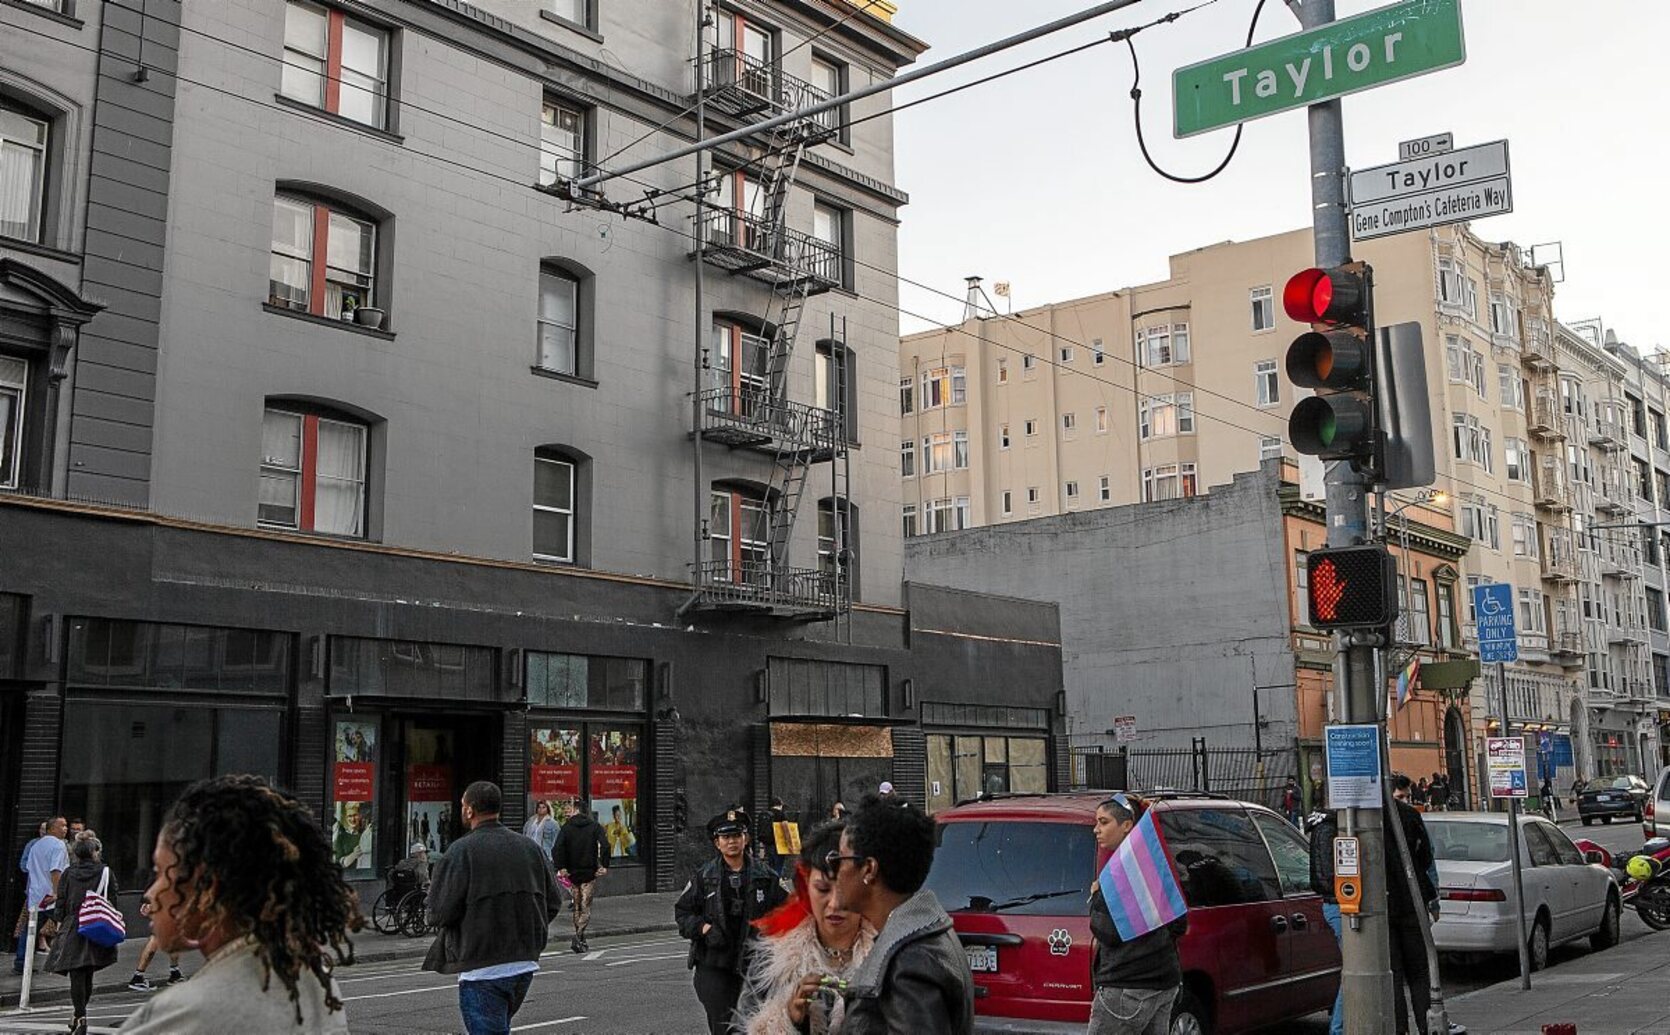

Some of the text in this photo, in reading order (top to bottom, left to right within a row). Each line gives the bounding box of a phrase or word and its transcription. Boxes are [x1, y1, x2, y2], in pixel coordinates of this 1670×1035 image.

[1223, 32, 1402, 105] Taylor
[1406, 140, 1430, 156] 100
[1386, 160, 1468, 190] Taylor
[1355, 187, 1505, 232] Gene Compton's Cafeteria Way
[1478, 614, 1512, 627] PARKING
[1485, 627, 1506, 639] ONLY
